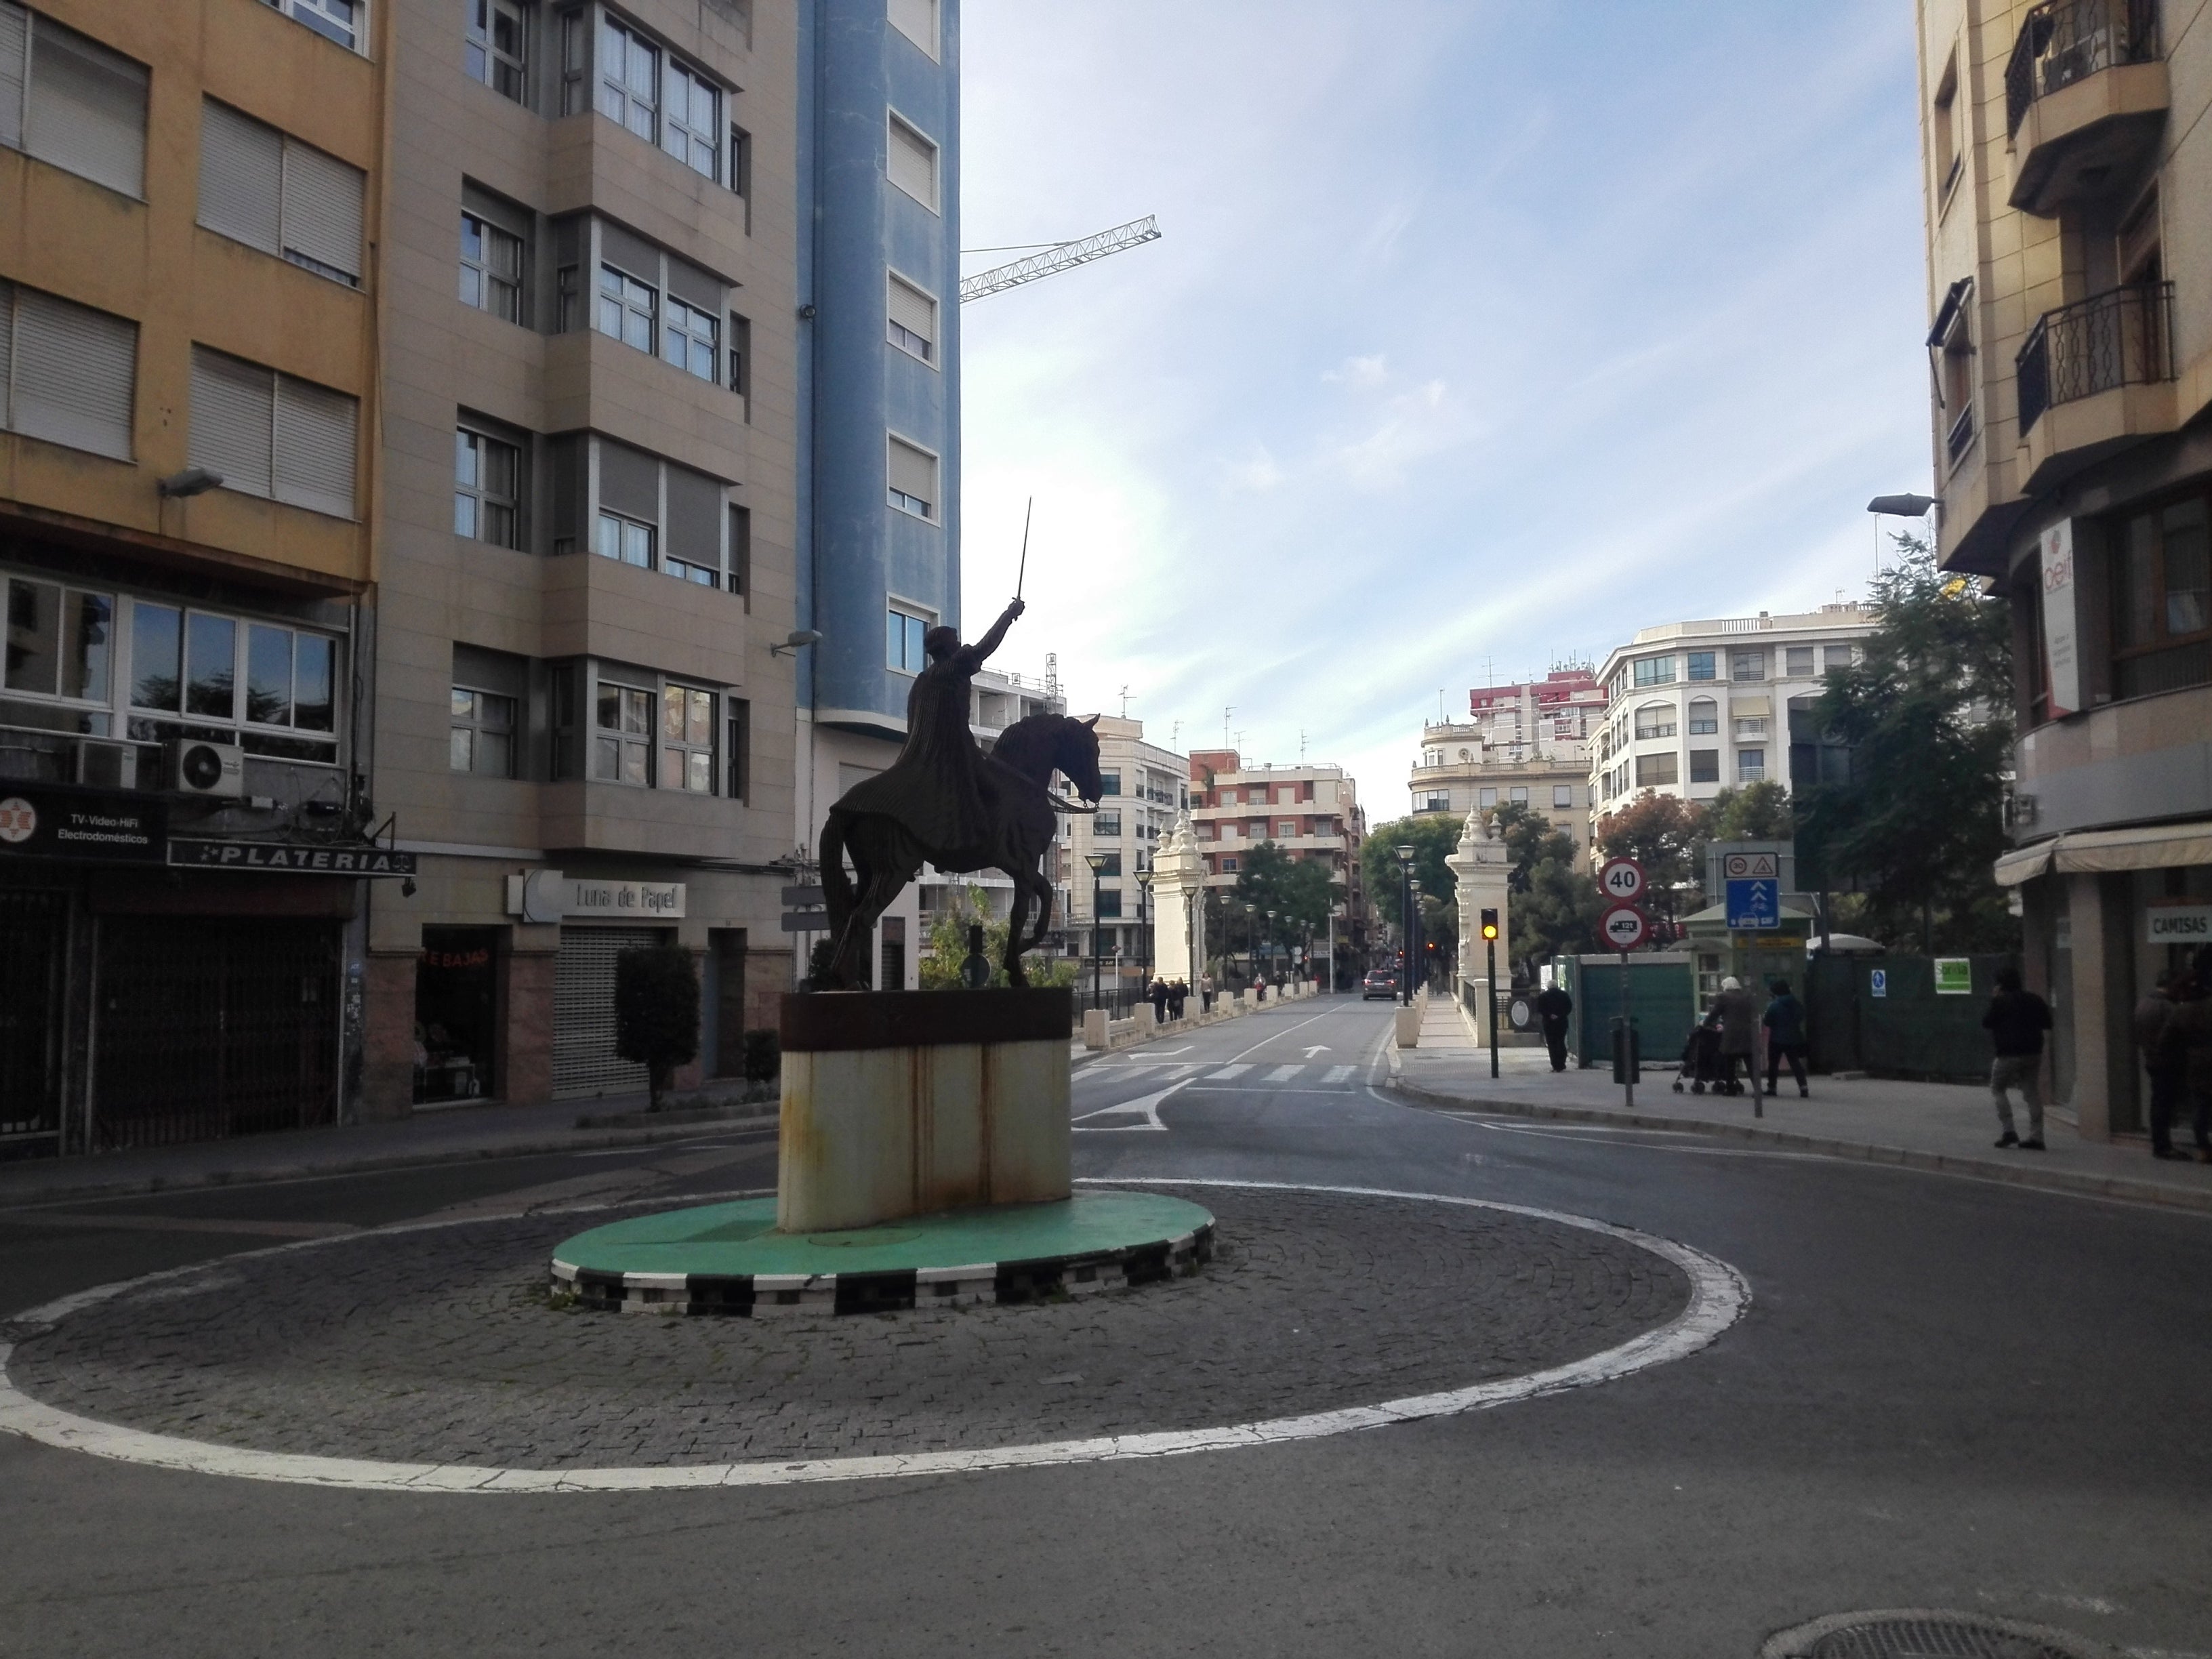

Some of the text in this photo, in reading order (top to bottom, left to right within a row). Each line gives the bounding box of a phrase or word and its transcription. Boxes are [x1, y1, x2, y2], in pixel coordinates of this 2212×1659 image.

[58, 828, 148, 844] Electrodomésticos
[220, 846, 390, 871] PLATERIA
[1610, 871, 1635, 888] 40
[577, 884, 676, 913] Luna de Papel
[2154, 917, 2207, 934] CAMISAS
